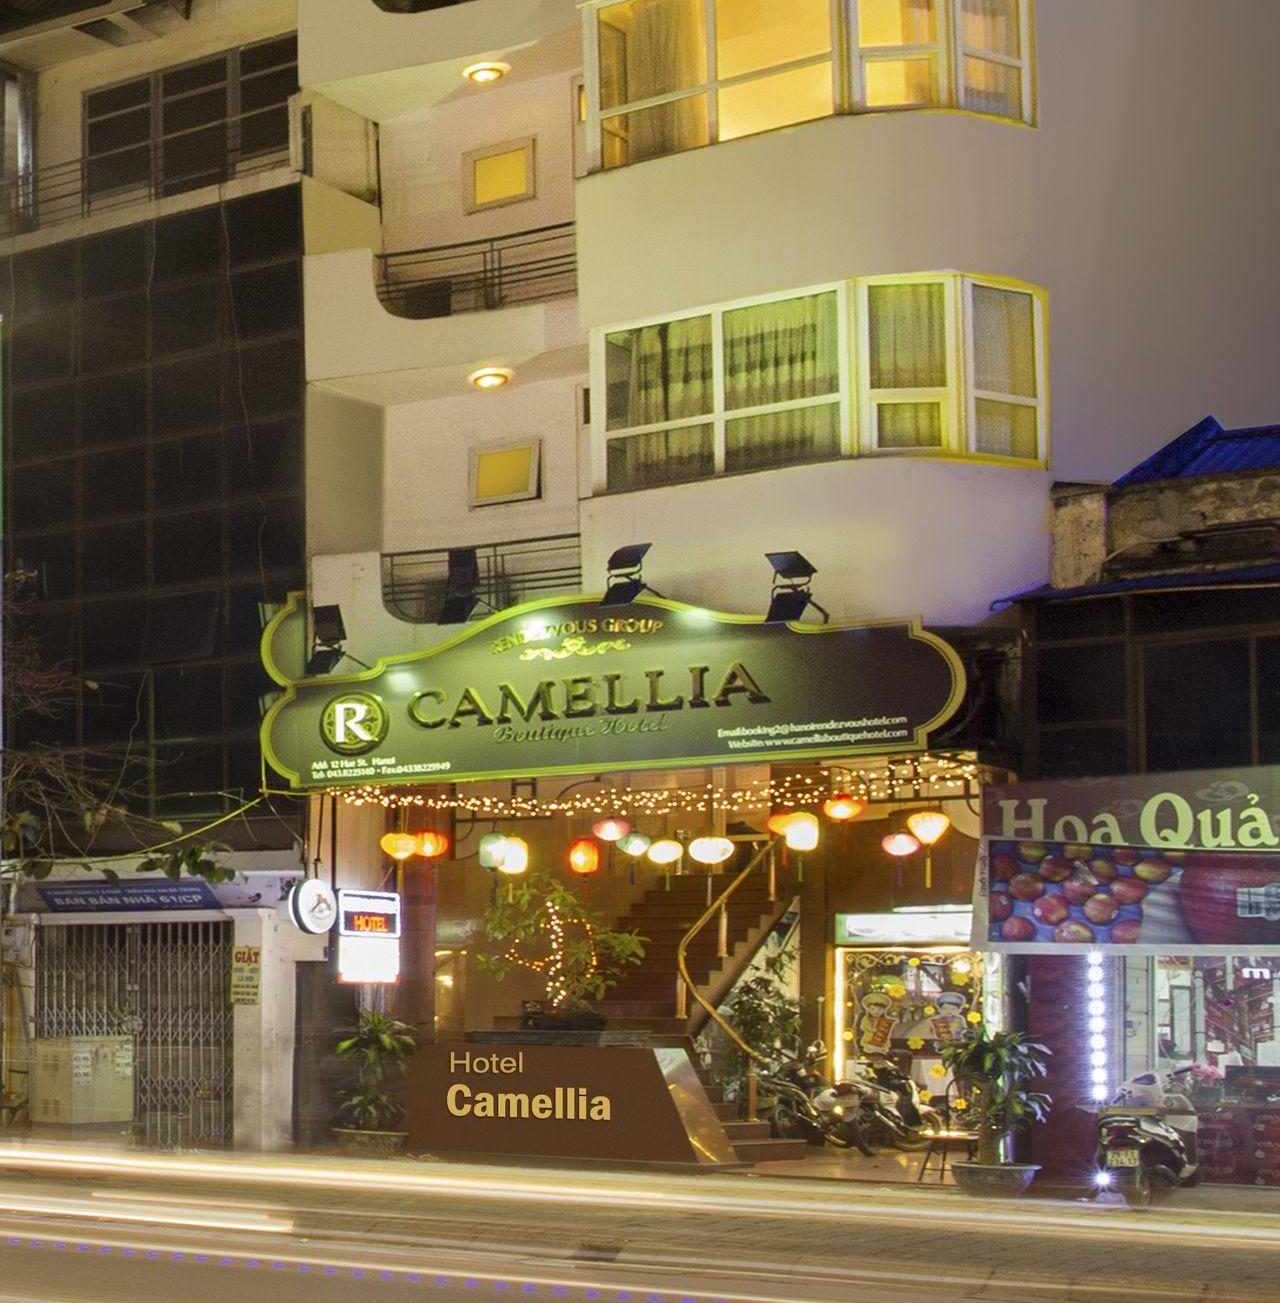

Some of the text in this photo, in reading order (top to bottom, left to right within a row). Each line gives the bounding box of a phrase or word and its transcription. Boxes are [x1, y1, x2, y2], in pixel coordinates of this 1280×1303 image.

[600, 617, 664, 634] GROUP
[407, 662, 772, 730] CAMELLIA
[493, 712, 669, 745] Boutique Hotel
[999, 792, 1280, 848] Hoa Quả
[354, 913, 388, 932] HOTEL
[450, 1051, 524, 1074] Hotel
[446, 1083, 611, 1121] Camellia
